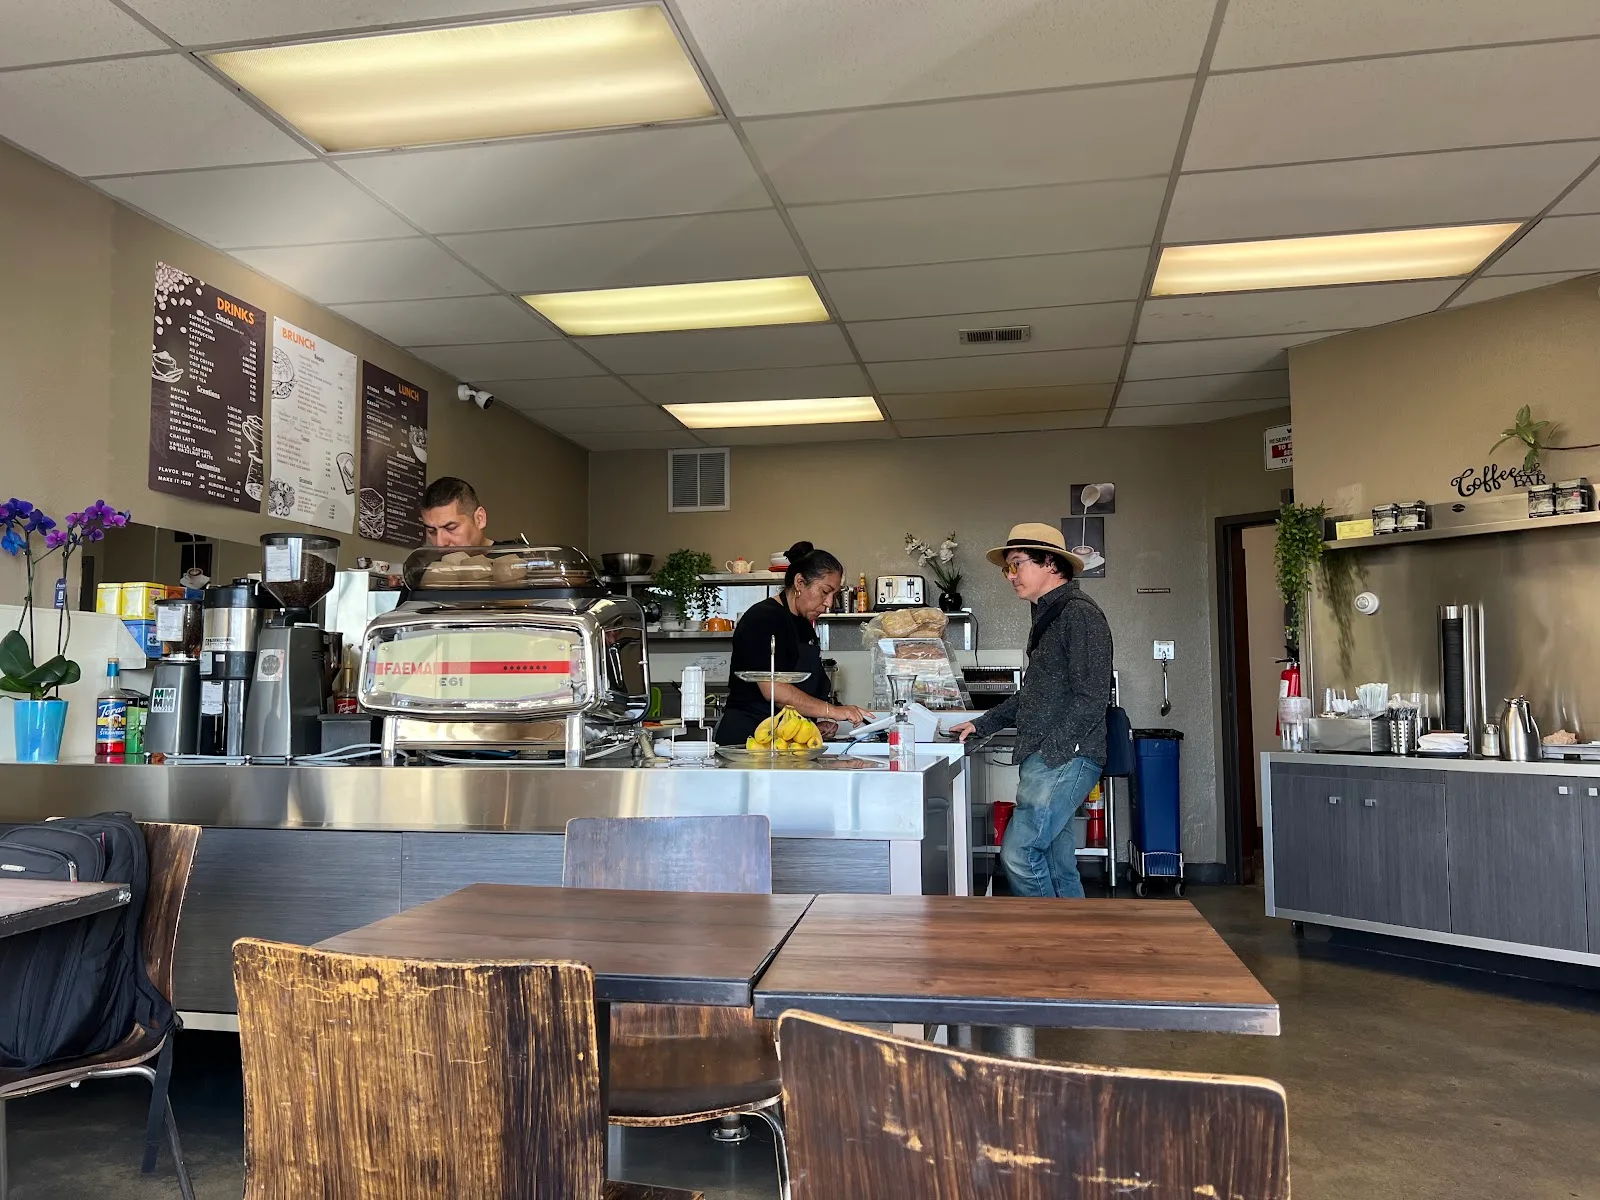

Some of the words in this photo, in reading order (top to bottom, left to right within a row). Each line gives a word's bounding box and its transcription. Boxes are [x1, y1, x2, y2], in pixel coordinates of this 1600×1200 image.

[217, 296, 254, 325] DRINKS
[189, 313, 210, 326] ESPRESSO
[189, 321, 214, 334] AMERICANO
[189, 327, 216, 342] CAPPUCCINO
[189, 334, 202, 343] LATTE
[282, 327, 316, 352] BRUNCH
[189, 354, 199, 362] ICED
[200, 358, 214, 368] COFFEE
[189, 361, 200, 369] COLD
[170, 386, 190, 397] HAVANA
[196, 385, 221, 400] Creations
[398, 383, 419, 402] LUNCH
[170, 394, 188, 403] MOCHA
[170, 402, 185, 410] WHITE
[185, 405, 202, 415] MOCHA
[181, 412, 207, 425] CHOCOLATE
[169, 425, 191, 435] STEAMER
[170, 417, 181, 425] KIDS
[182, 420, 192, 428] HOT
[192, 423, 217, 435] CHOCOLATE
[182, 435, 196, 443] LATTE
[177, 447, 201, 457] HAZELNUT
[201, 452, 214, 461] LATTE
[192, 446, 211, 455] CARAMEL
[158, 466, 179, 475] FLAVOR
[182, 470, 194, 478] SHOT
[195, 460, 221, 473] Customize
[157, 475, 173, 483] MAKE
[217, 474, 227, 482] MILK
[1451, 464, 1517, 497] Coffee
[1513, 473, 1546, 488] BAR
[384, 661, 433, 675] FAEMA
[439, 677, 463, 687] E61
